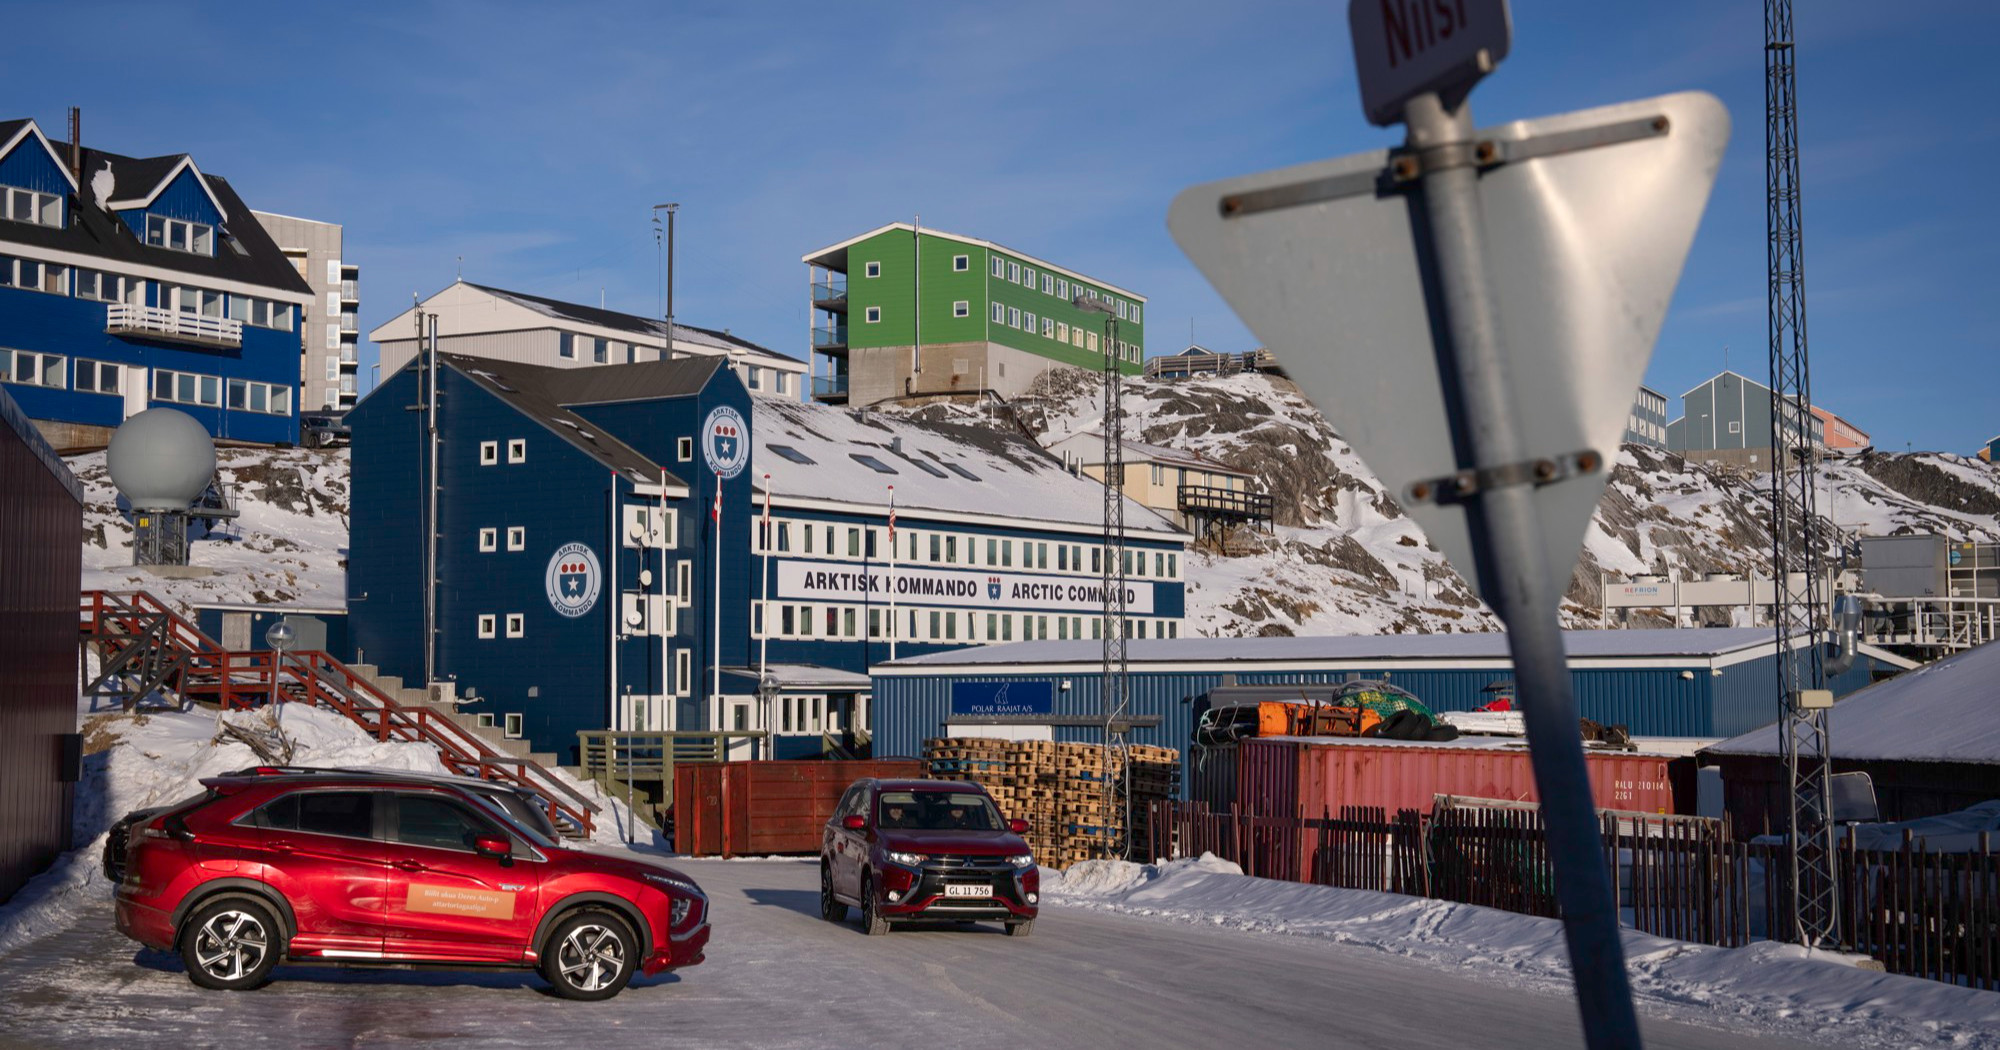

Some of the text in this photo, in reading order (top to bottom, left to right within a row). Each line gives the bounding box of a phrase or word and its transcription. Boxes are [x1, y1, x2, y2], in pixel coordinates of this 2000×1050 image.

[712, 407, 738, 420] ARKTISK
[709, 460, 742, 478] KOMANDO
[558, 544, 589, 557] ARKTISK
[804, 571, 879, 592] ARKTISK
[885, 575, 977, 597] KOMMANDO
[1012, 582, 1063, 601] ARCTIC
[554, 600, 593, 616] KOMMANDO
[971, 705, 1033, 713] POLAR RAAJAT A/S
[1615, 780, 1633, 790] RALU
[1615, 791, 1632, 800] 22G1
[457, 892, 476, 901] Deres
[949, 886, 990, 896] GL 11 756
